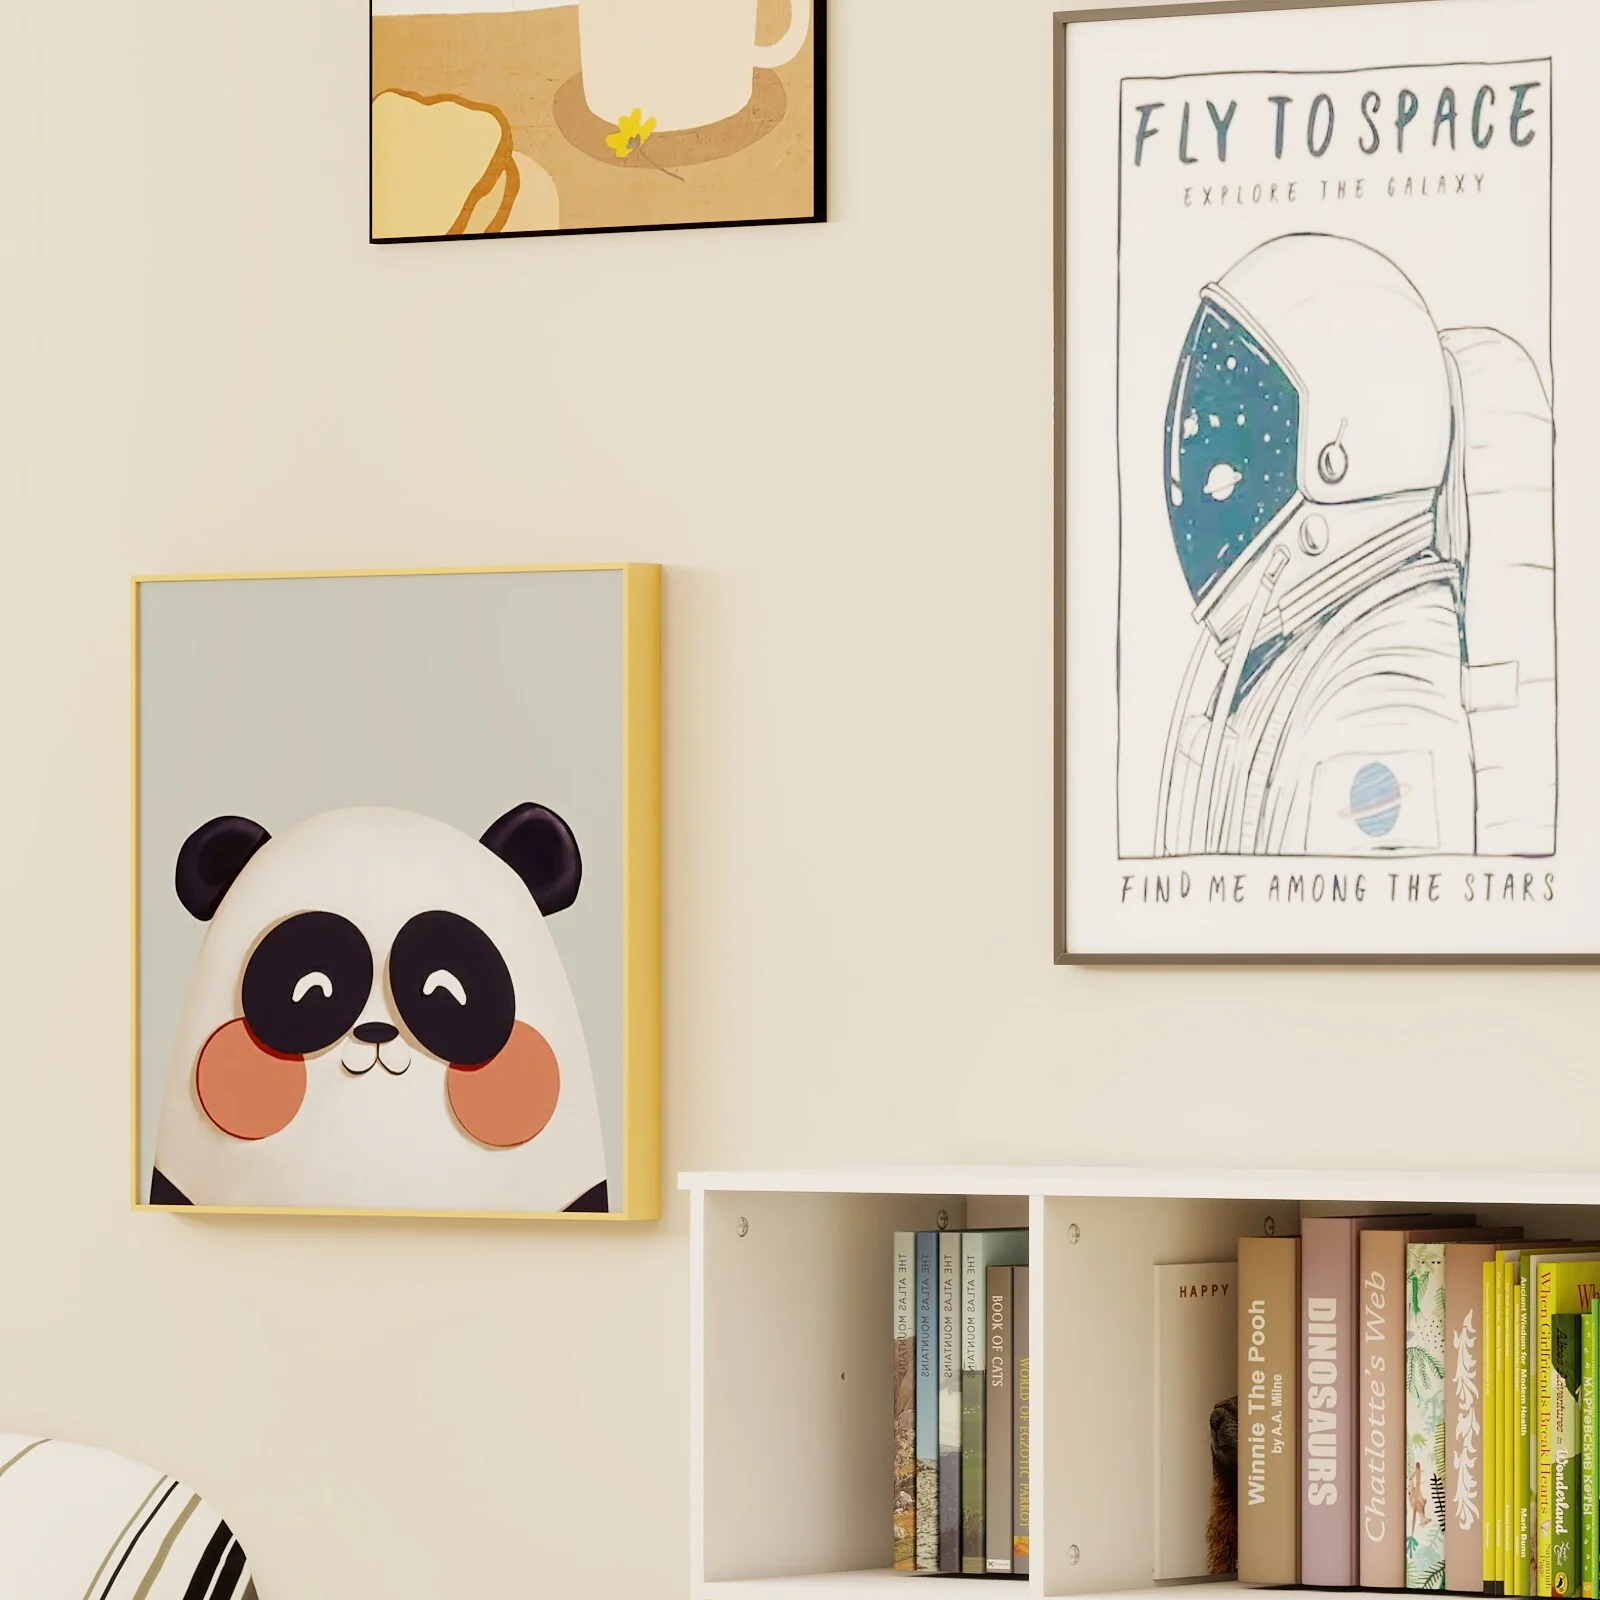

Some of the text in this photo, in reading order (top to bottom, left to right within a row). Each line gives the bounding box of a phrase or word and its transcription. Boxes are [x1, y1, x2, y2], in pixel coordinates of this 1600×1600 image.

[1133, 82, 1541, 167] FLY TO SPACE
[1183, 173, 1487, 208] EXPLORE THE GALAXY
[1121, 871, 1556, 903] FIND ME AMONG THE STARS
[1179, 1284, 1229, 1298] HAPPY
[1364, 1270, 1386, 1345] Web
[992, 1295, 1004, 1387] BOOK OF CATS
[1520, 1276, 1528, 1436] Ancient Wisdom for Modern Health
[1247, 1299, 1266, 1506] Winnie The Pooh
[1271, 1373, 1285, 1454] by A.A. Milne
[1307, 1297, 1338, 1506] DINOSAURS
[1540, 1272, 1551, 1514] When Girlfriends Break Hearts
[1520, 1508, 1528, 1558] Mark Bunn
[1555, 1448, 1570, 1535] Wonderland
